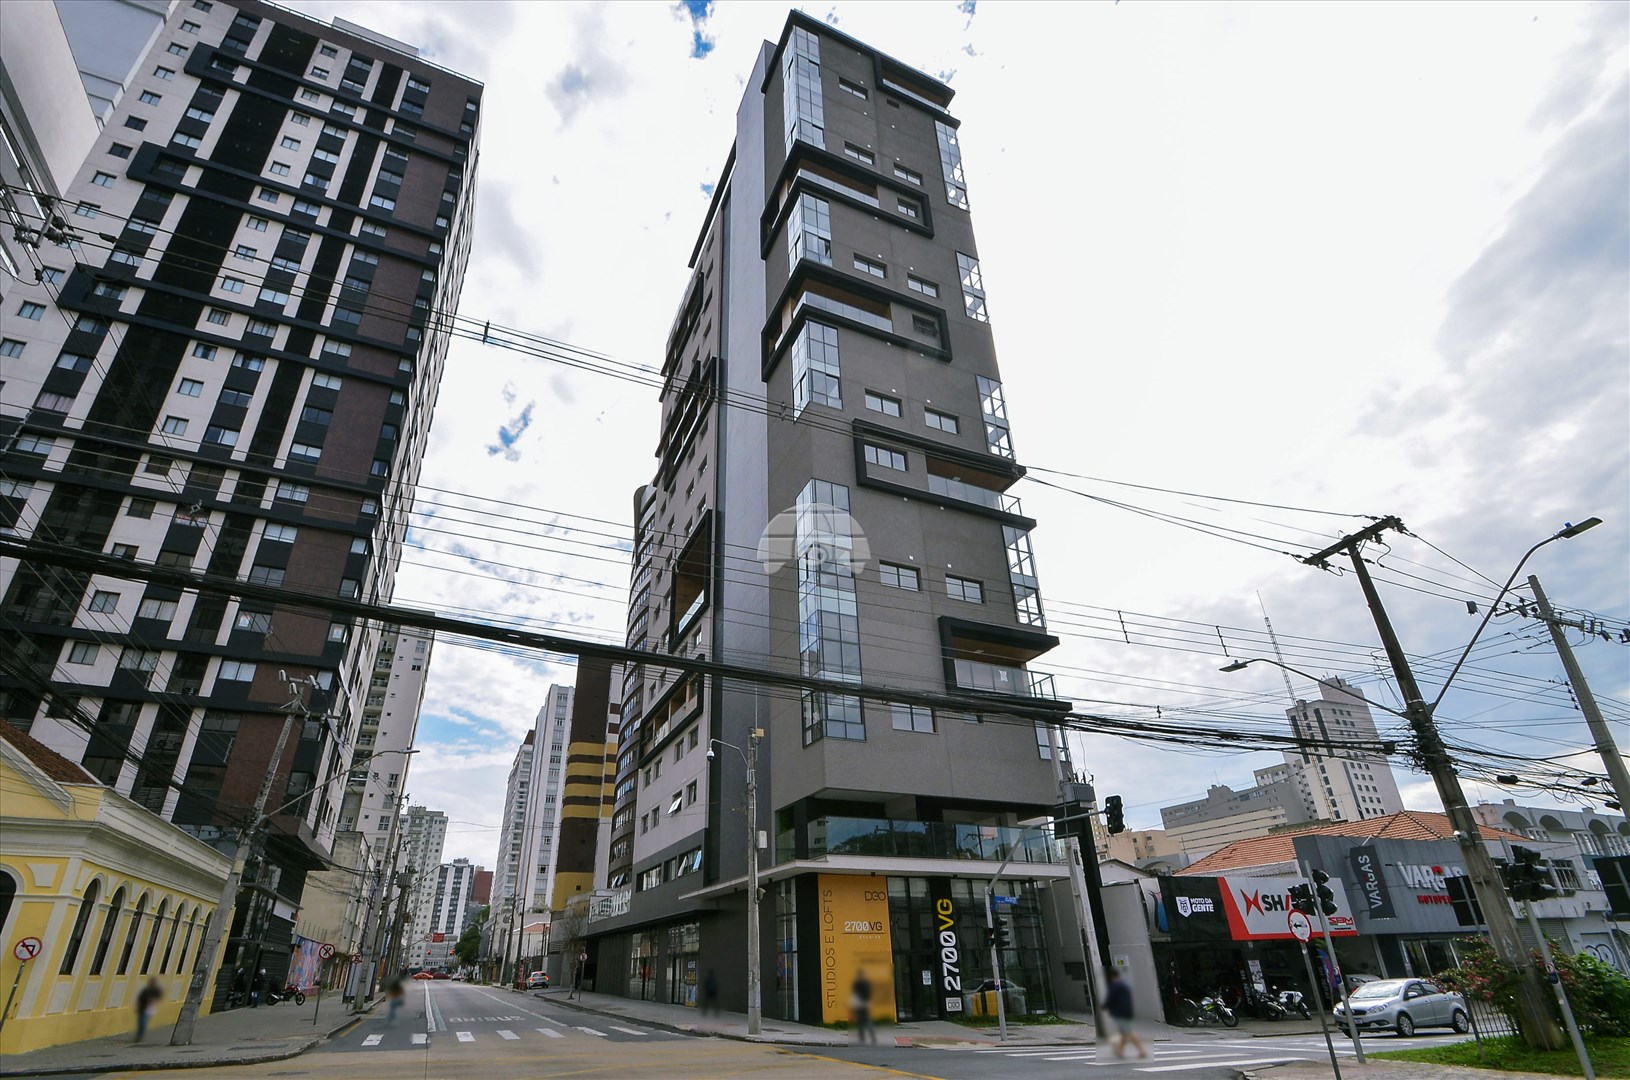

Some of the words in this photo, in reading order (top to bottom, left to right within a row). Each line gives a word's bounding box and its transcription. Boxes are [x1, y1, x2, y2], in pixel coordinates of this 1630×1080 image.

[1358, 854, 1383, 909] VARGAS
[822, 889, 834, 932] LOFTS
[844, 921, 883, 932] 2700VG
[1192, 904, 1215, 912] GENTE
[936, 898, 961, 991] 2700VG
[825, 947, 836, 1009] STUDIOS
